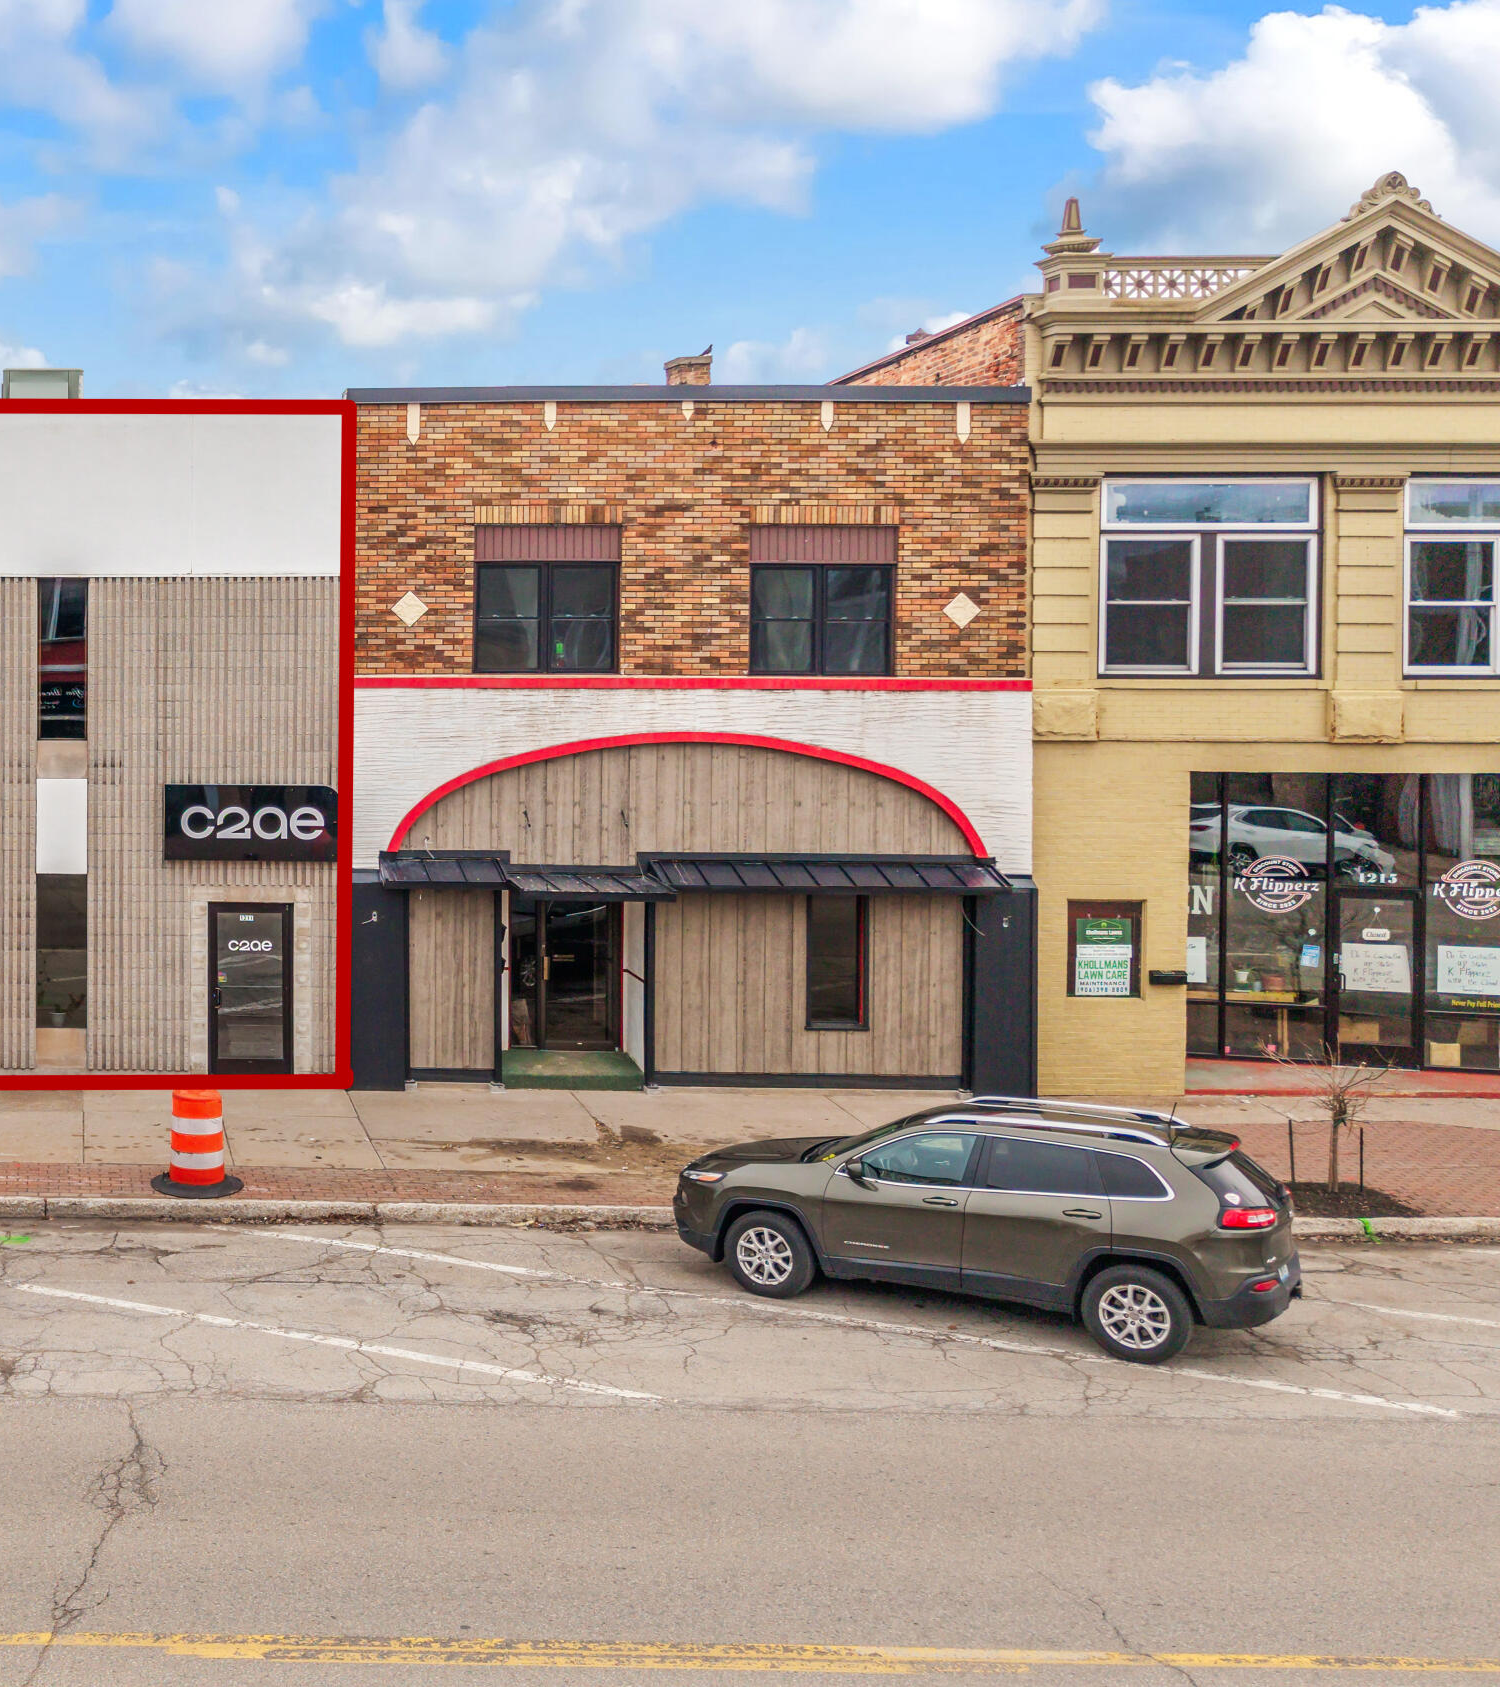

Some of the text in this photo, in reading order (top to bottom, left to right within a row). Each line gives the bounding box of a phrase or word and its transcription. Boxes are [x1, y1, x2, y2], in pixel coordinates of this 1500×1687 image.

[180, 805, 325, 841] c2ae
[1253, 860, 1301, 874] DISCOUNT STORE
[1452, 865, 1482, 879] DISCOUNT
[1234, 877, 1320, 893] K Flipperz
[1359, 873, 1398, 884] 1215
[1433, 883, 1446, 898] K
[1188, 885, 1215, 915] N
[1256, 897, 1278, 909] SINCE
[1456, 904, 1478, 916] SINCE
[228, 939, 273, 952] c2ae
[1077, 960, 1129, 970] KHOLLMANS
[1078, 970, 1128, 980] LAWN CARE
